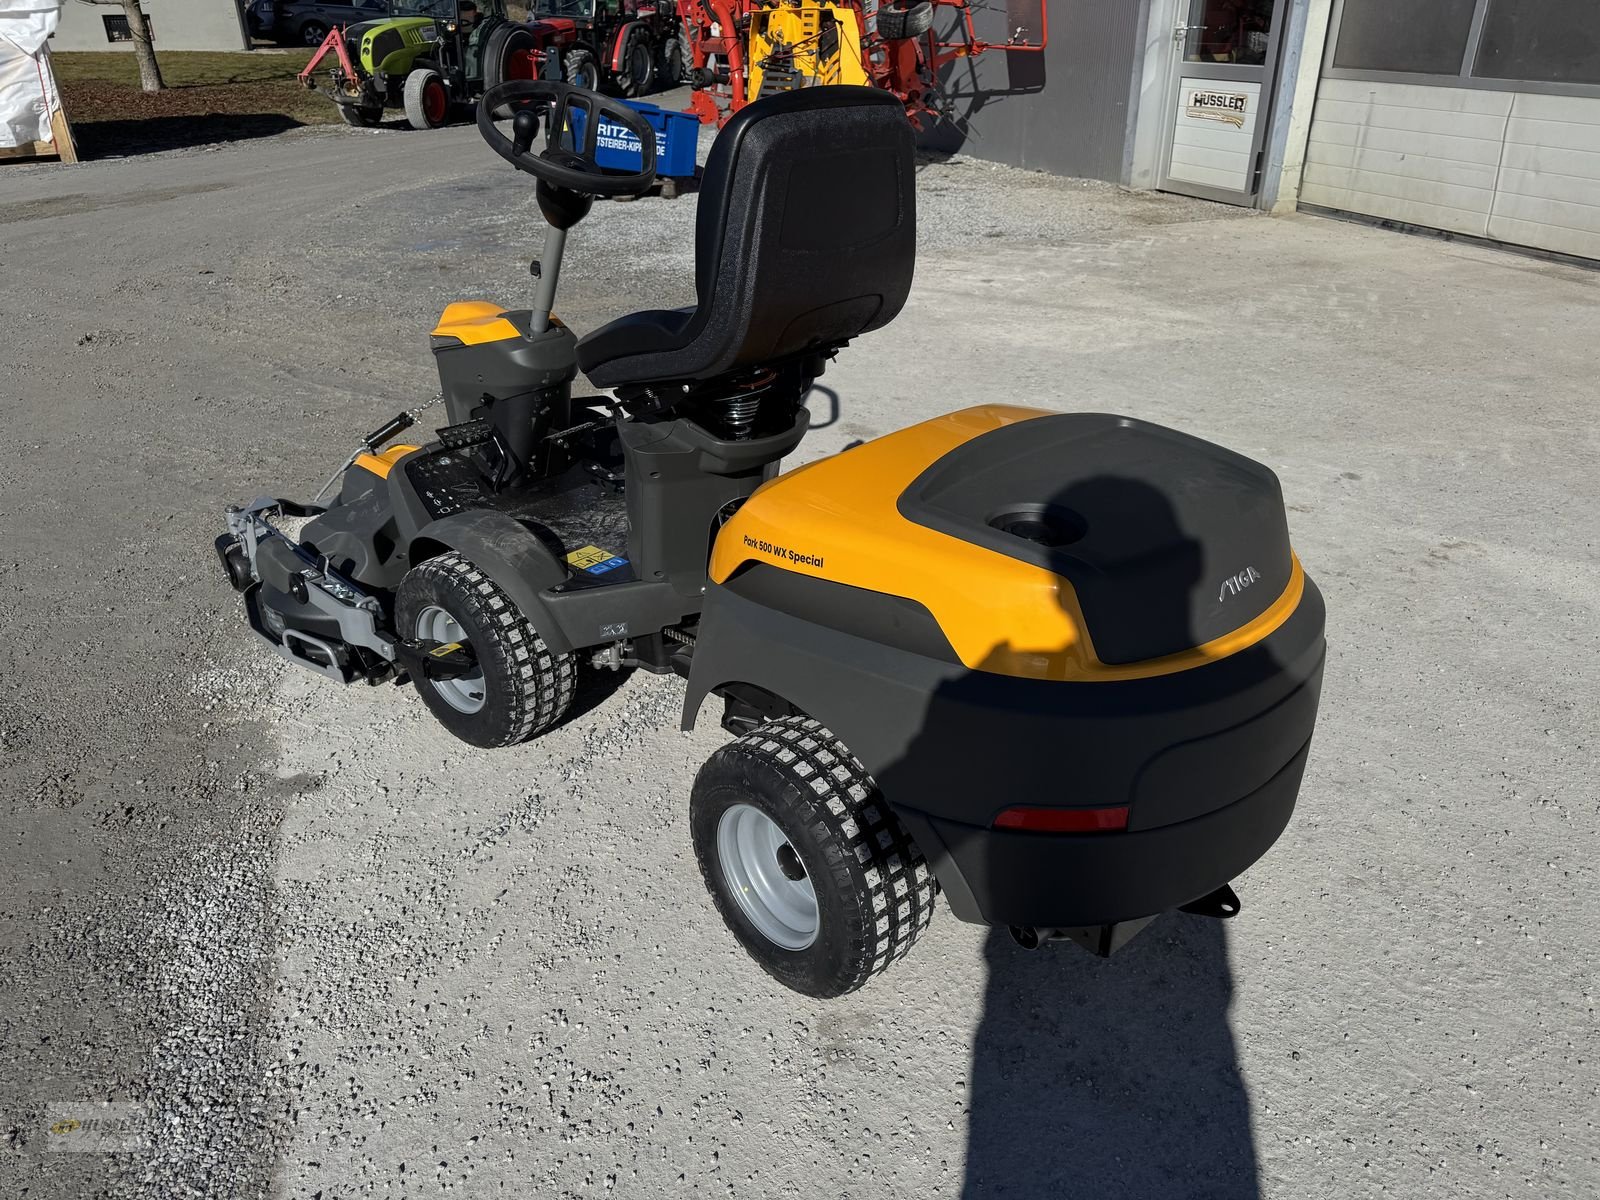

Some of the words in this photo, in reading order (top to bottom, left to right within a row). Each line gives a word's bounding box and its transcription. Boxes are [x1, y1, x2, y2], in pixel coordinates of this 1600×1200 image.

[743, 534, 758, 550] Park
[759, 540, 773, 554] 500
[773, 545, 787, 559] WX
[788, 550, 824, 568] Special
[1218, 566, 1261, 602] STIGA
